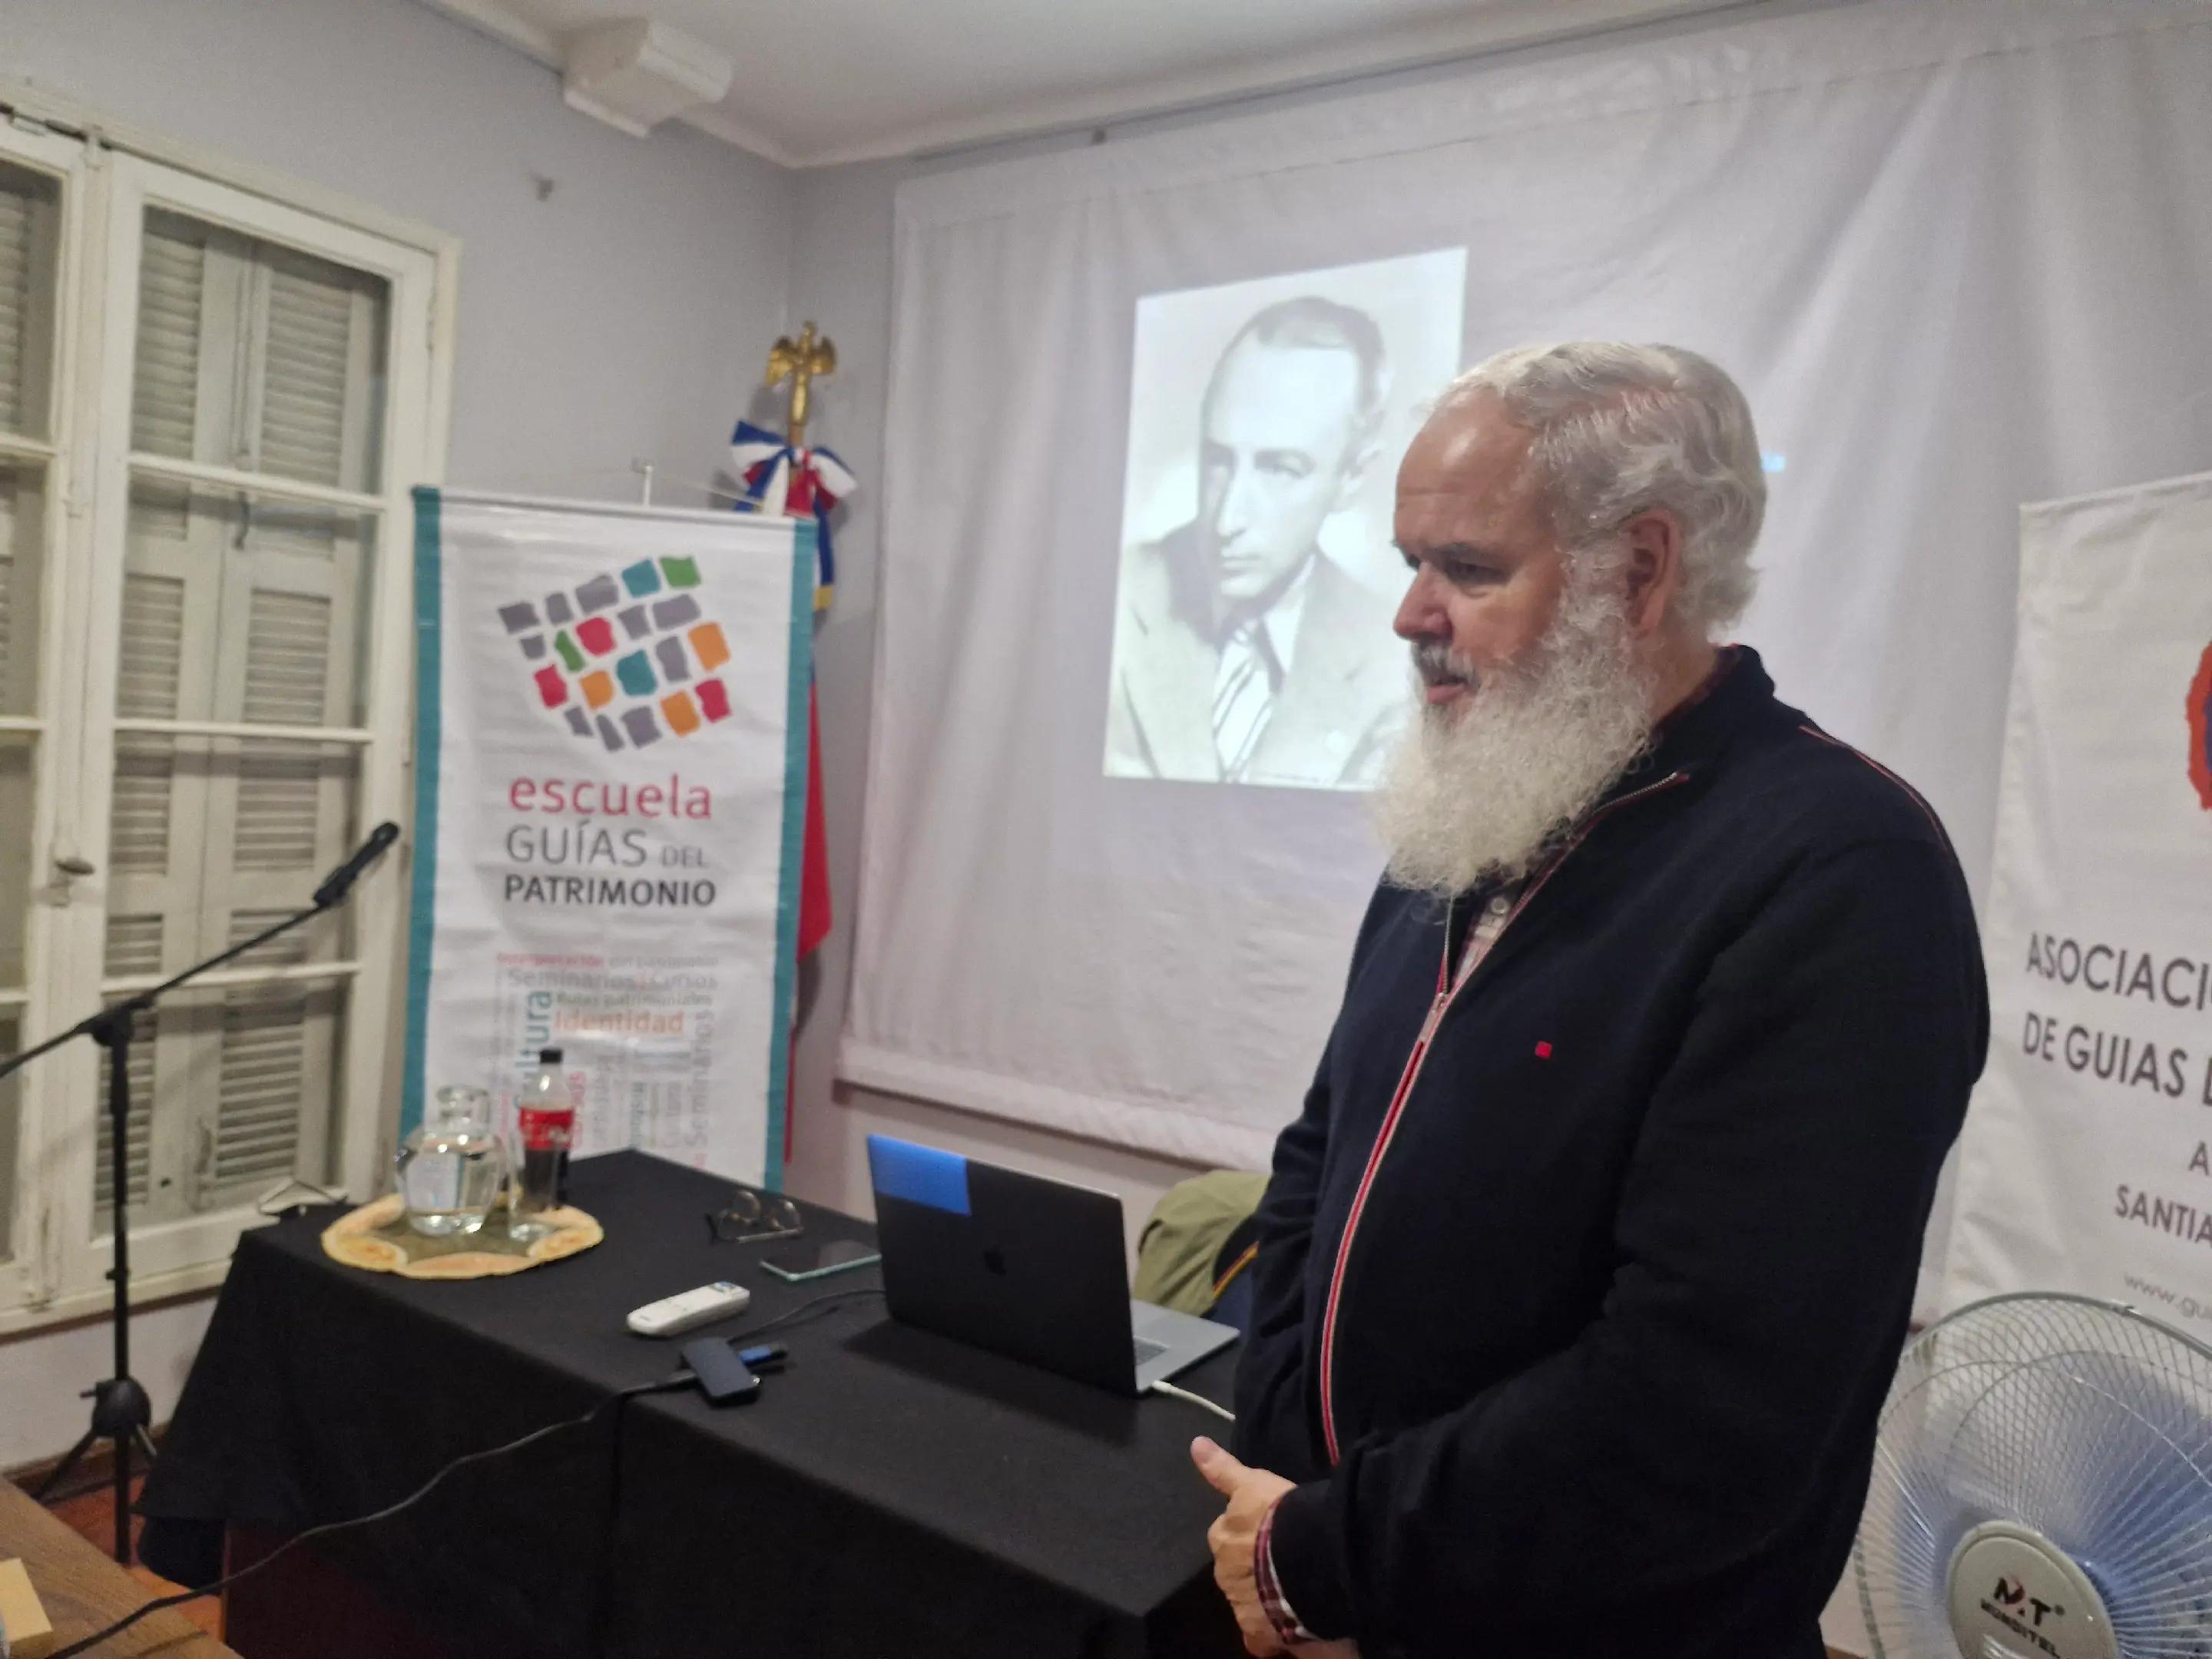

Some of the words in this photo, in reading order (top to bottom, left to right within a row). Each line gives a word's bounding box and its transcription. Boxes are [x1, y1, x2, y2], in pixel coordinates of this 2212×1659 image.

[508, 773, 711, 820] escuela
[505, 819, 647, 867] GUÍAS
[661, 846, 710, 868] DEL
[503, 873, 717, 907] PATRIMONIO
[2026, 931, 2212, 1012] ASOCIACI
[554, 1008, 684, 1035] Identidad
[2023, 1011, 2058, 1061] DE
[2065, 1024, 2187, 1098] GUIAS
[2115, 1184, 2212, 1248] SANTIA
